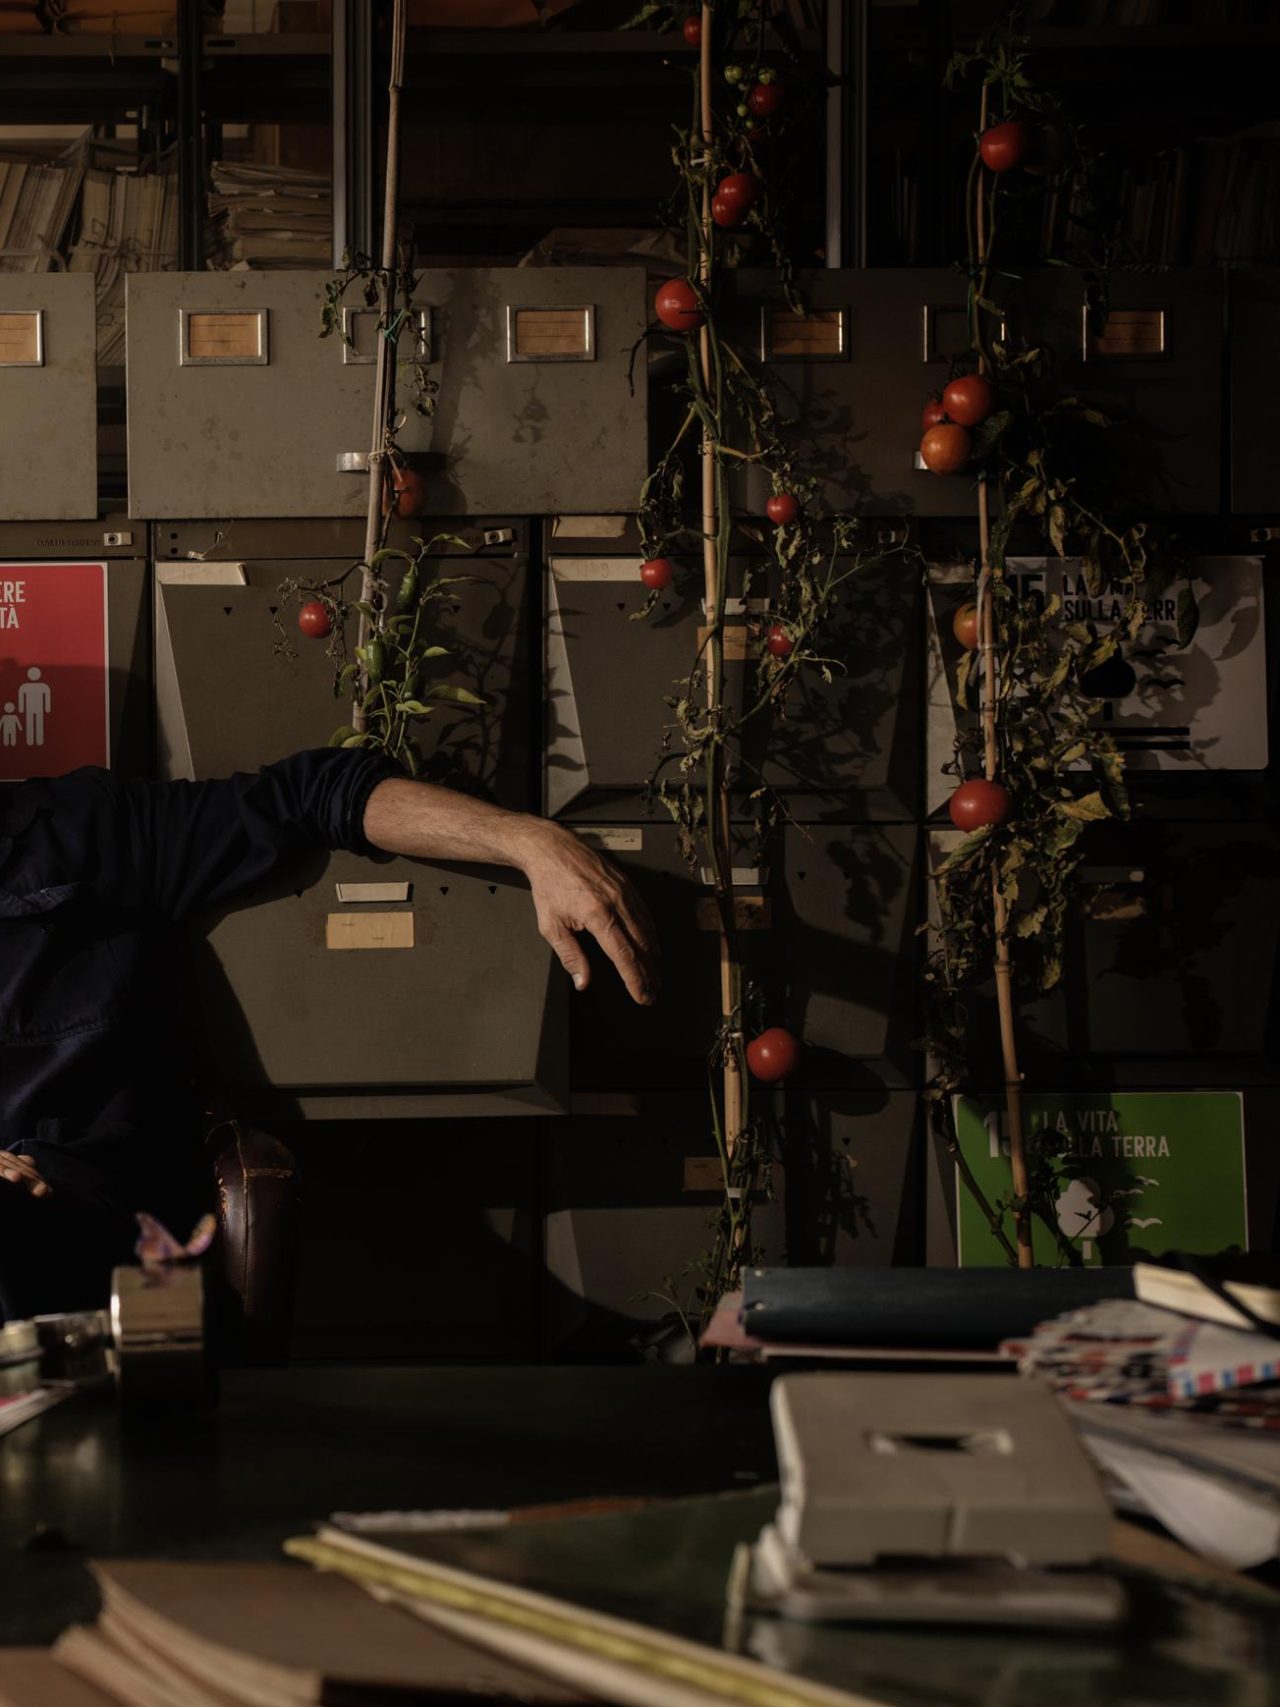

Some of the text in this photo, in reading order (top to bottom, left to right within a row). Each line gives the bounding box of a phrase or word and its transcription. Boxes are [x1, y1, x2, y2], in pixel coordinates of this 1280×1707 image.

[1064, 599, 1121, 621] SULLA
[1077, 1110, 1119, 1133] VITA
[1111, 1135, 1171, 1158] TERRA
